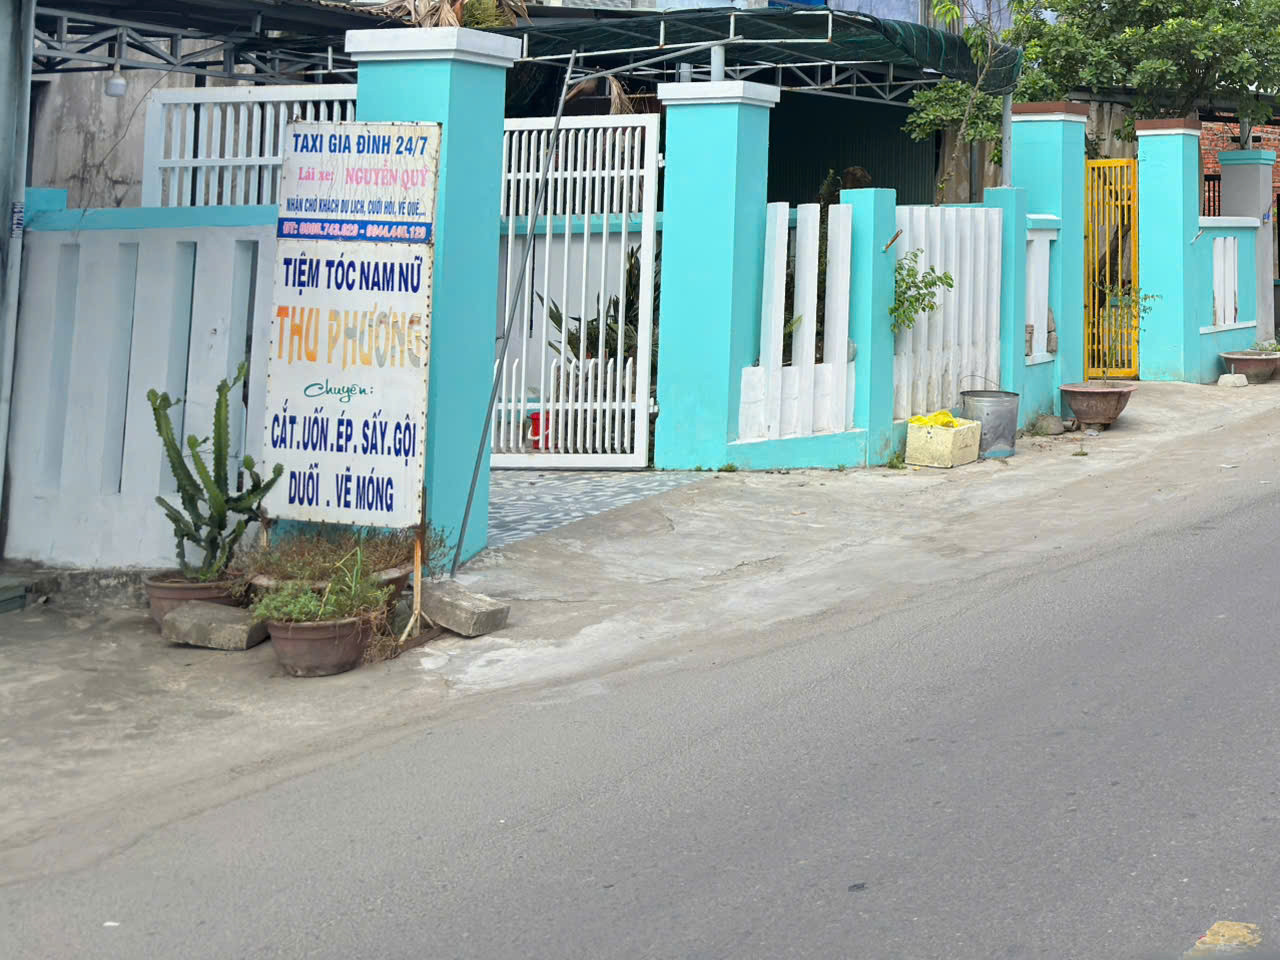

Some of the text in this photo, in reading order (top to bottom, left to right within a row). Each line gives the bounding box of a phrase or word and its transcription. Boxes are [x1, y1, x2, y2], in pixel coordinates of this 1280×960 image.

[293, 130, 428, 157] TAXI GIA ĐÌNH 24/7
[298, 167, 315, 182] Lái
[283, 250, 423, 296] TIỆM TÓC NAM NỮ
[276, 303, 423, 371] THU PHƯƠNG
[335, 466, 353, 509] VẼ
[355, 467, 394, 512] MÓNG
